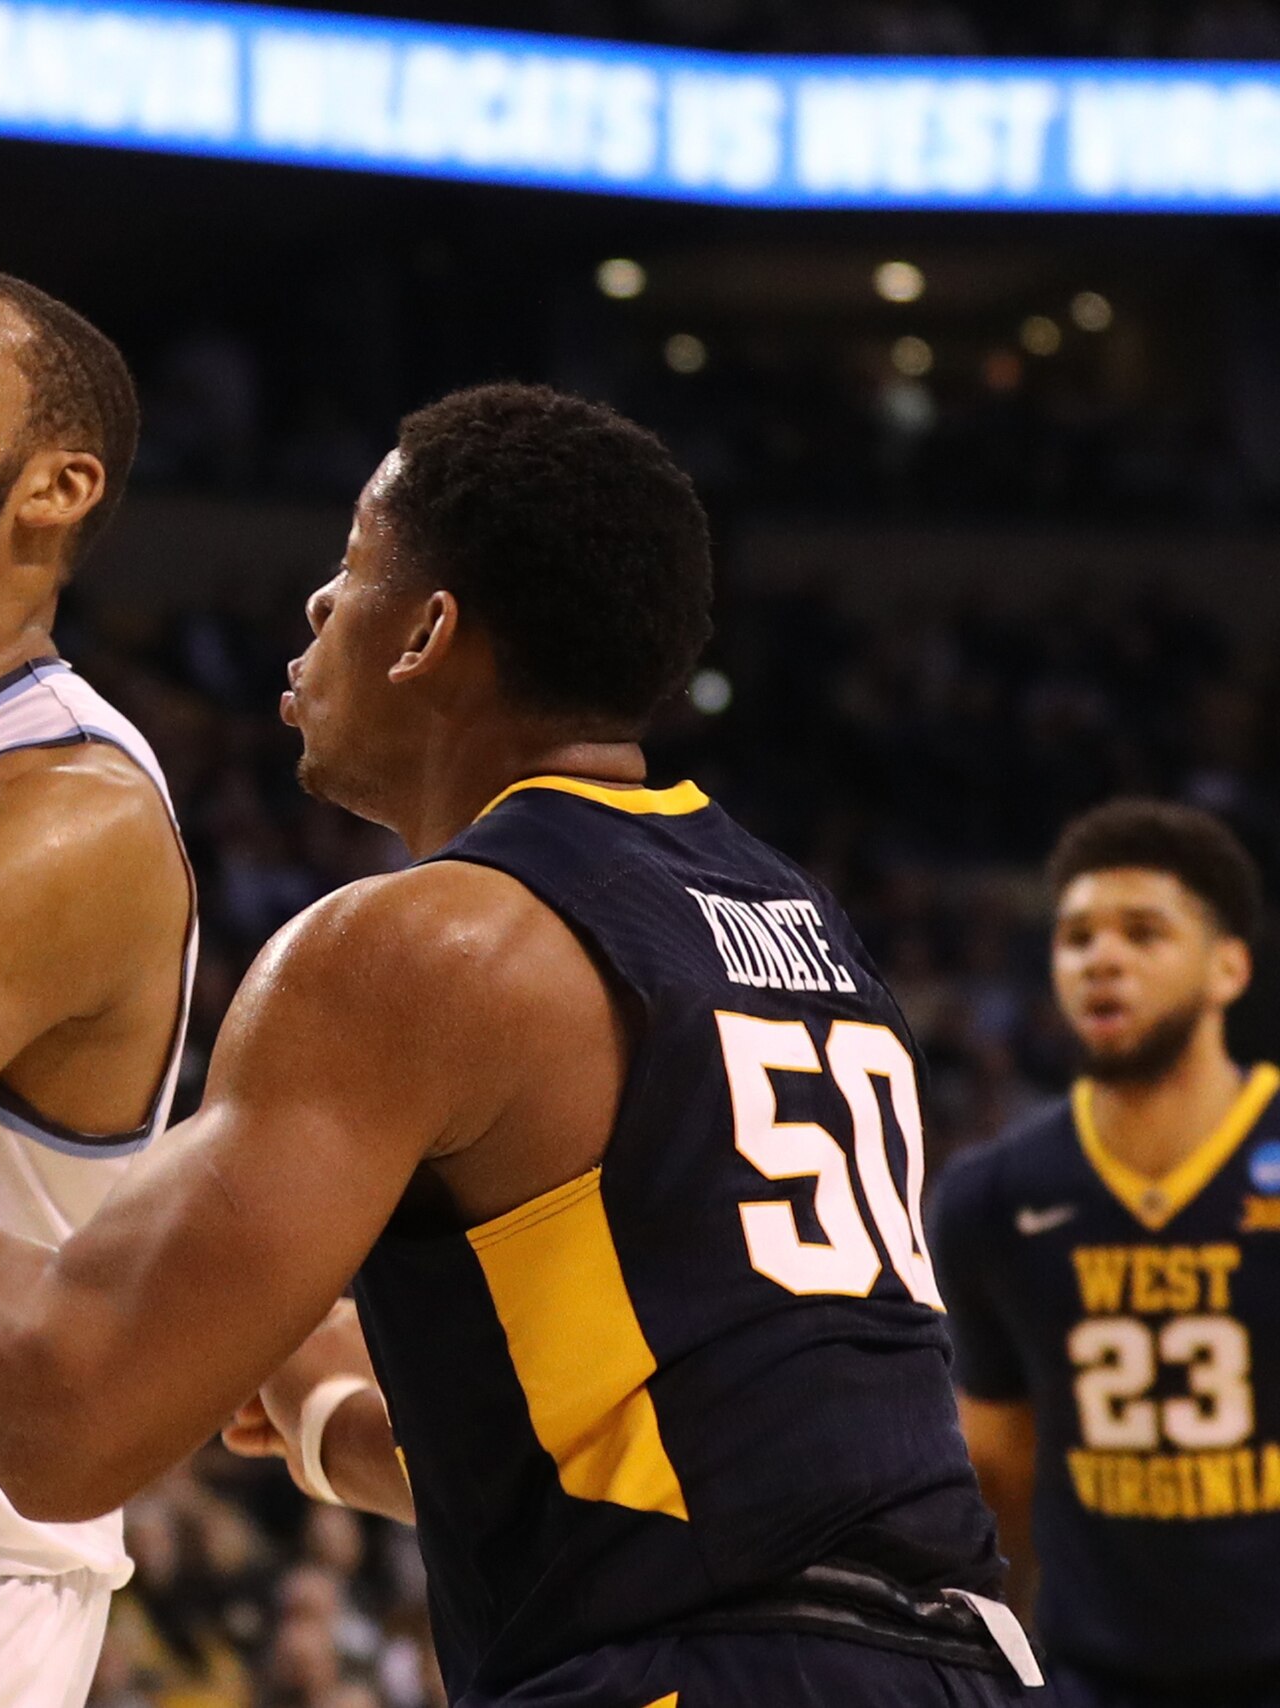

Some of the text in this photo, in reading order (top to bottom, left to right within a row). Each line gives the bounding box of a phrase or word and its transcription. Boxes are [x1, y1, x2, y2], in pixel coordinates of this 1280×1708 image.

[253, 35, 657, 181] WILDCATS
[668, 71, 783, 187] VS
[795, 78, 1057, 194] WEST
[685, 886, 857, 992] KONATE
[714, 1010, 947, 1314] 50
[1071, 1242, 1242, 1314] WEST
[1067, 1316, 1256, 1450] 23
